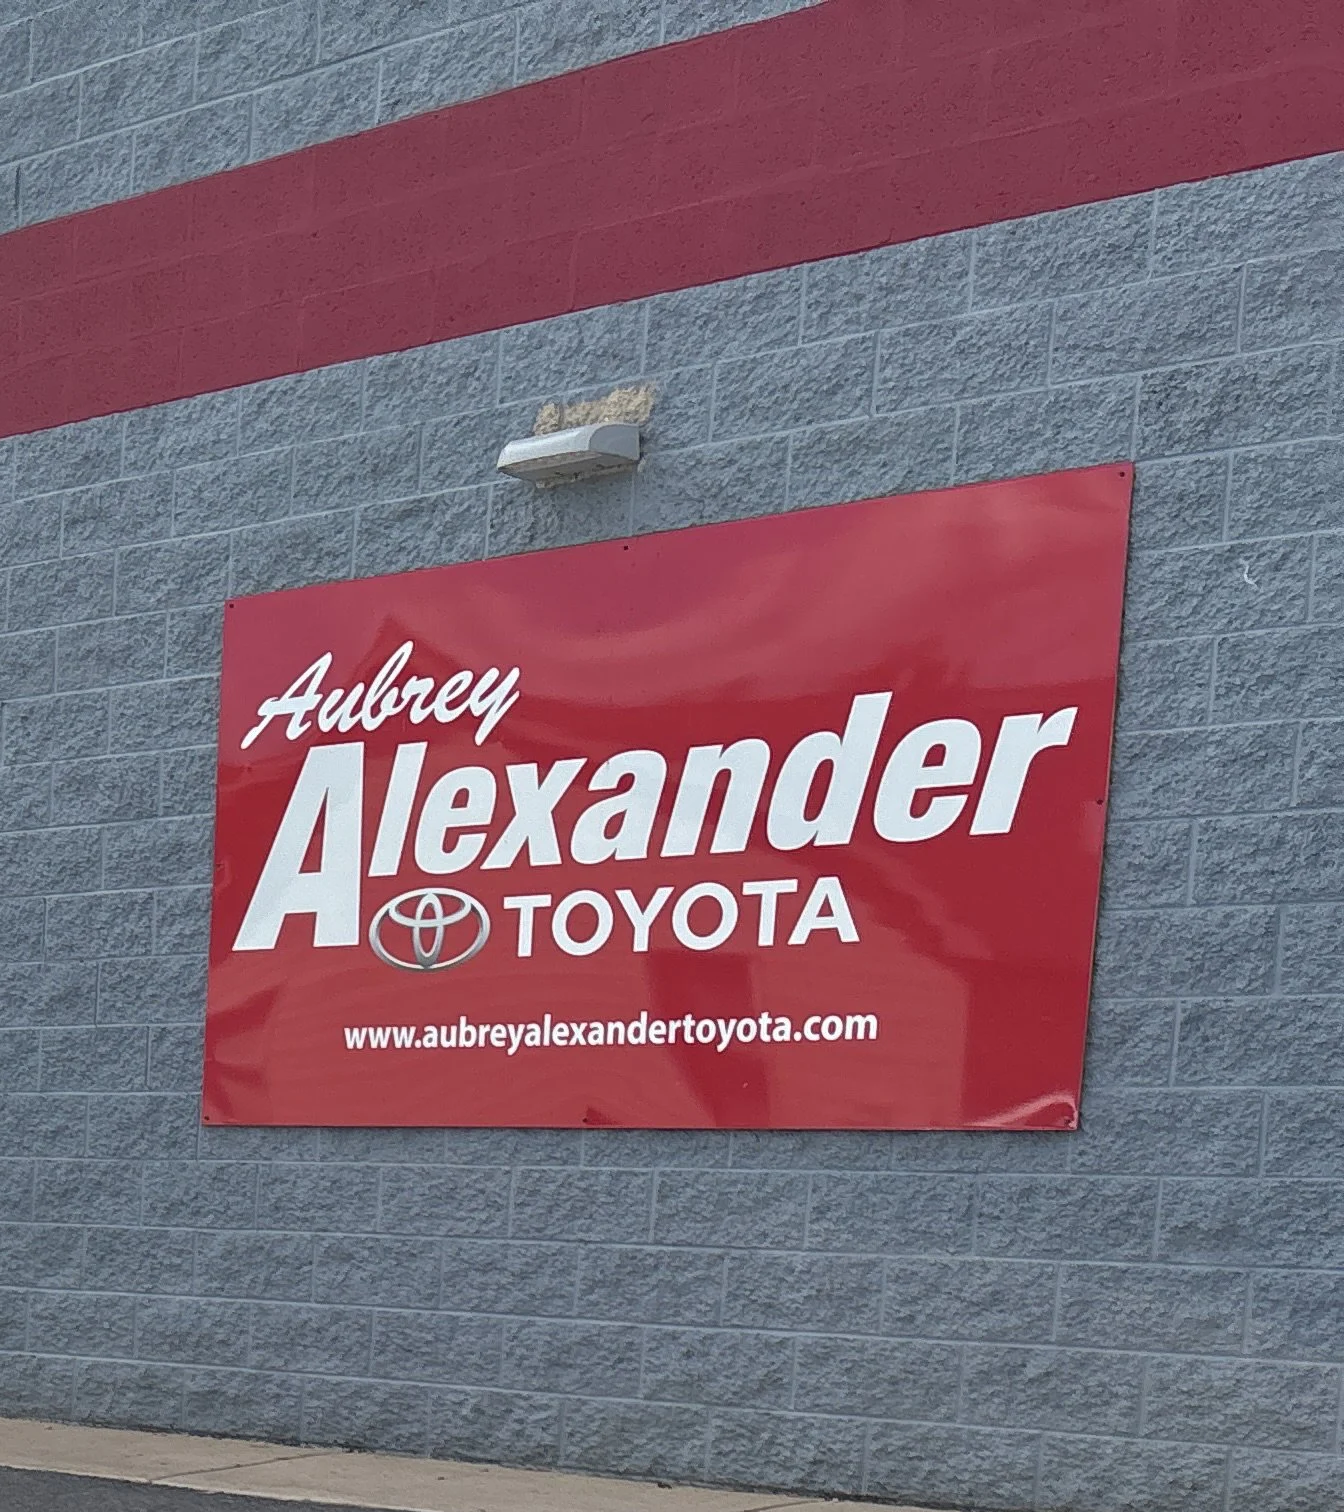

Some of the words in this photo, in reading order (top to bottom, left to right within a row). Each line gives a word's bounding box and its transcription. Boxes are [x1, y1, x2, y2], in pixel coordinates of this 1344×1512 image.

[240, 640, 521, 750] Aubrey
[231, 691, 1079, 952] Alexander
[503, 876, 861, 958] TOYOTA
[343, 1010, 878, 1056] www.aubreyalexandertoyota.com
